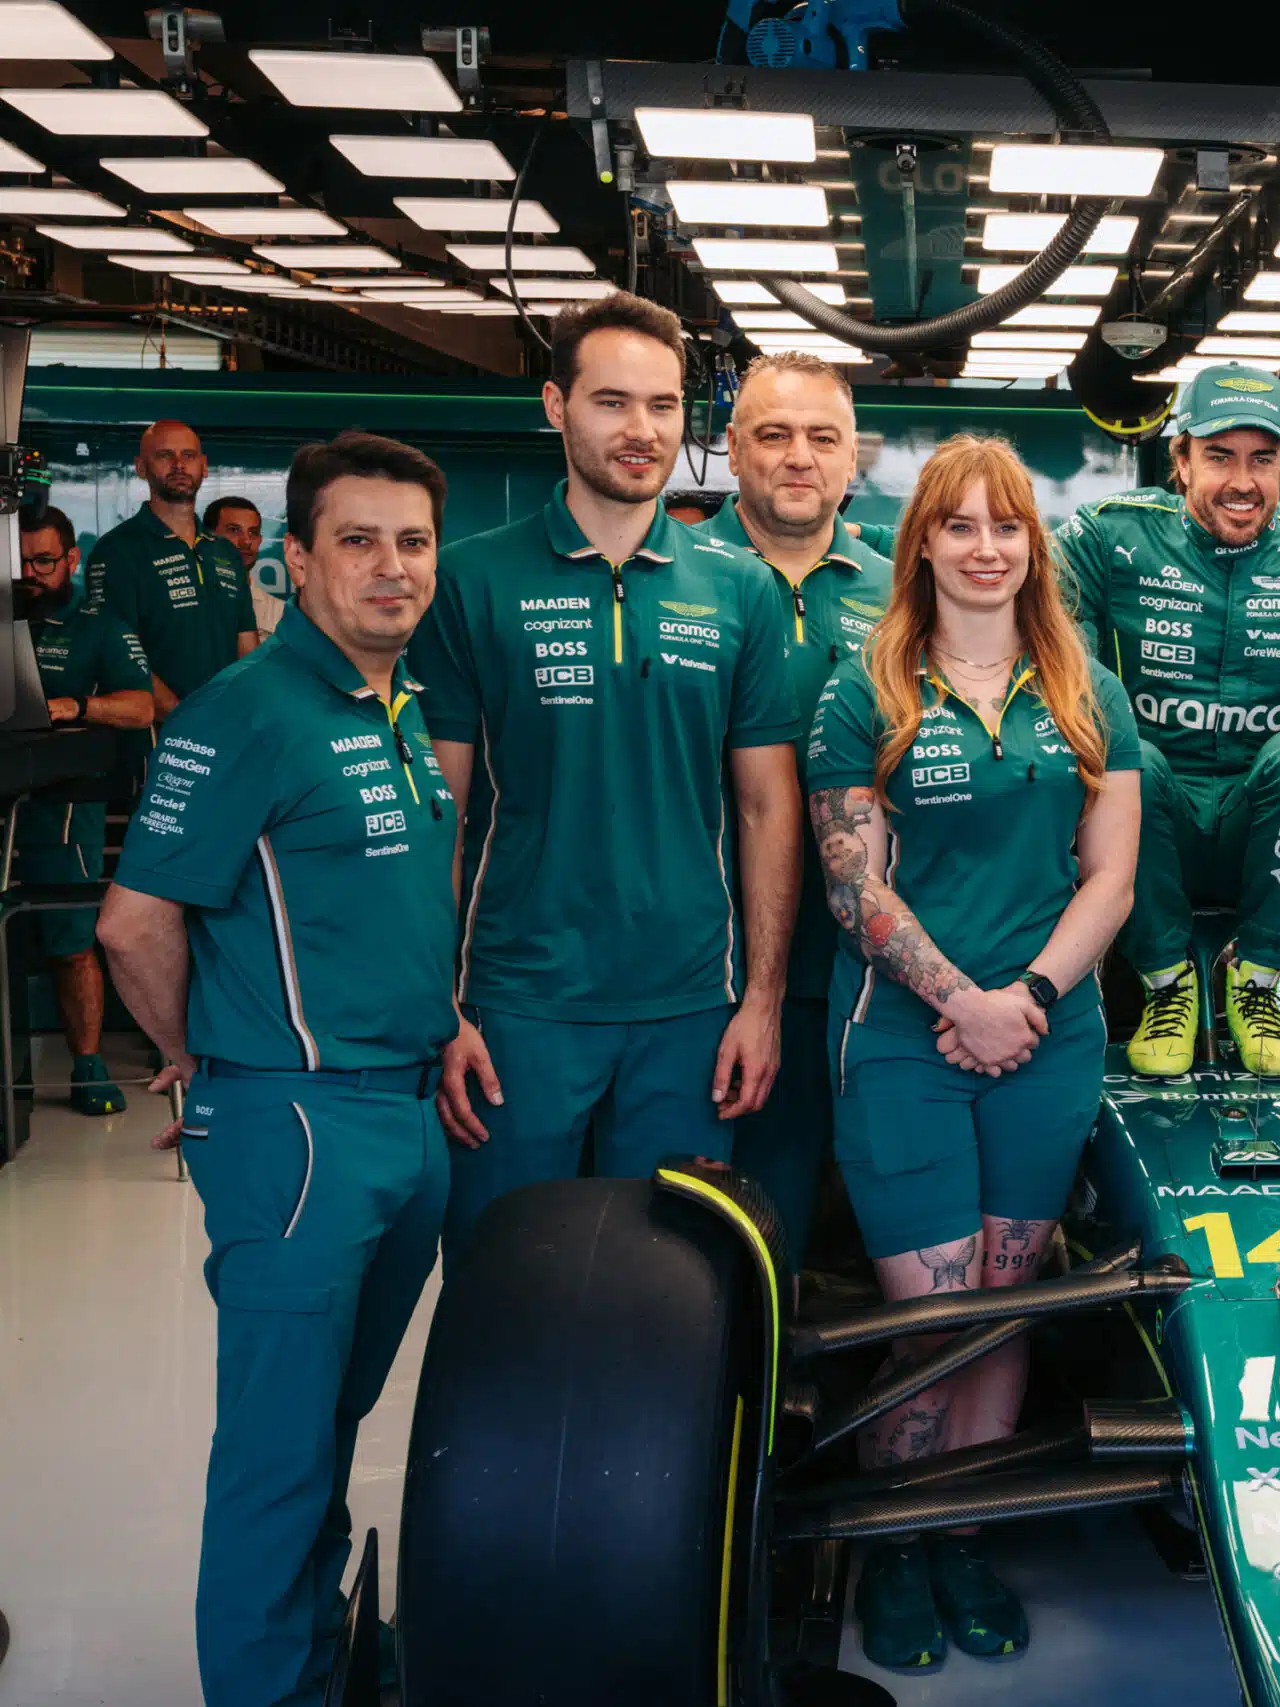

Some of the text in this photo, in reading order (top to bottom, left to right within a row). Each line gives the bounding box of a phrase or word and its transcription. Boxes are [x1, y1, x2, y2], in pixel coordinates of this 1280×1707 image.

[167, 575, 191, 587] BOSS
[1139, 576, 1205, 594] MAADEN
[170, 586, 196, 600] JCB
[520, 596, 590, 611] MAADEN
[1139, 595, 1204, 613] cognizant
[524, 617, 593, 633] cognizant
[659, 621, 720, 640] aramco
[1145, 617, 1193, 639] BOSS
[535, 641, 588, 658] BOSS
[1142, 640, 1194, 664] JCB
[679, 657, 716, 672] Valvoline
[1140, 665, 1194, 681] SentinelOne
[535, 666, 593, 687] JCB
[540, 695, 593, 706] SentinelOne
[922, 705, 957, 721] ADEN
[919, 724, 964, 739] gnizant
[164, 737, 216, 757] coinbase
[330, 734, 382, 754] MAADEN
[912, 744, 962, 760] BOSS
[164, 753, 211, 776] NexGen
[342, 757, 392, 777] cognizant
[913, 764, 969, 787] JCB
[359, 784, 397, 805] BOSS
[914, 792, 973, 806] SentinelOne
[139, 815, 185, 835] PERREGAUX
[149, 810, 177, 824] GIRARD
[367, 811, 405, 836] JCB
[365, 843, 409, 857] SentinelOne
